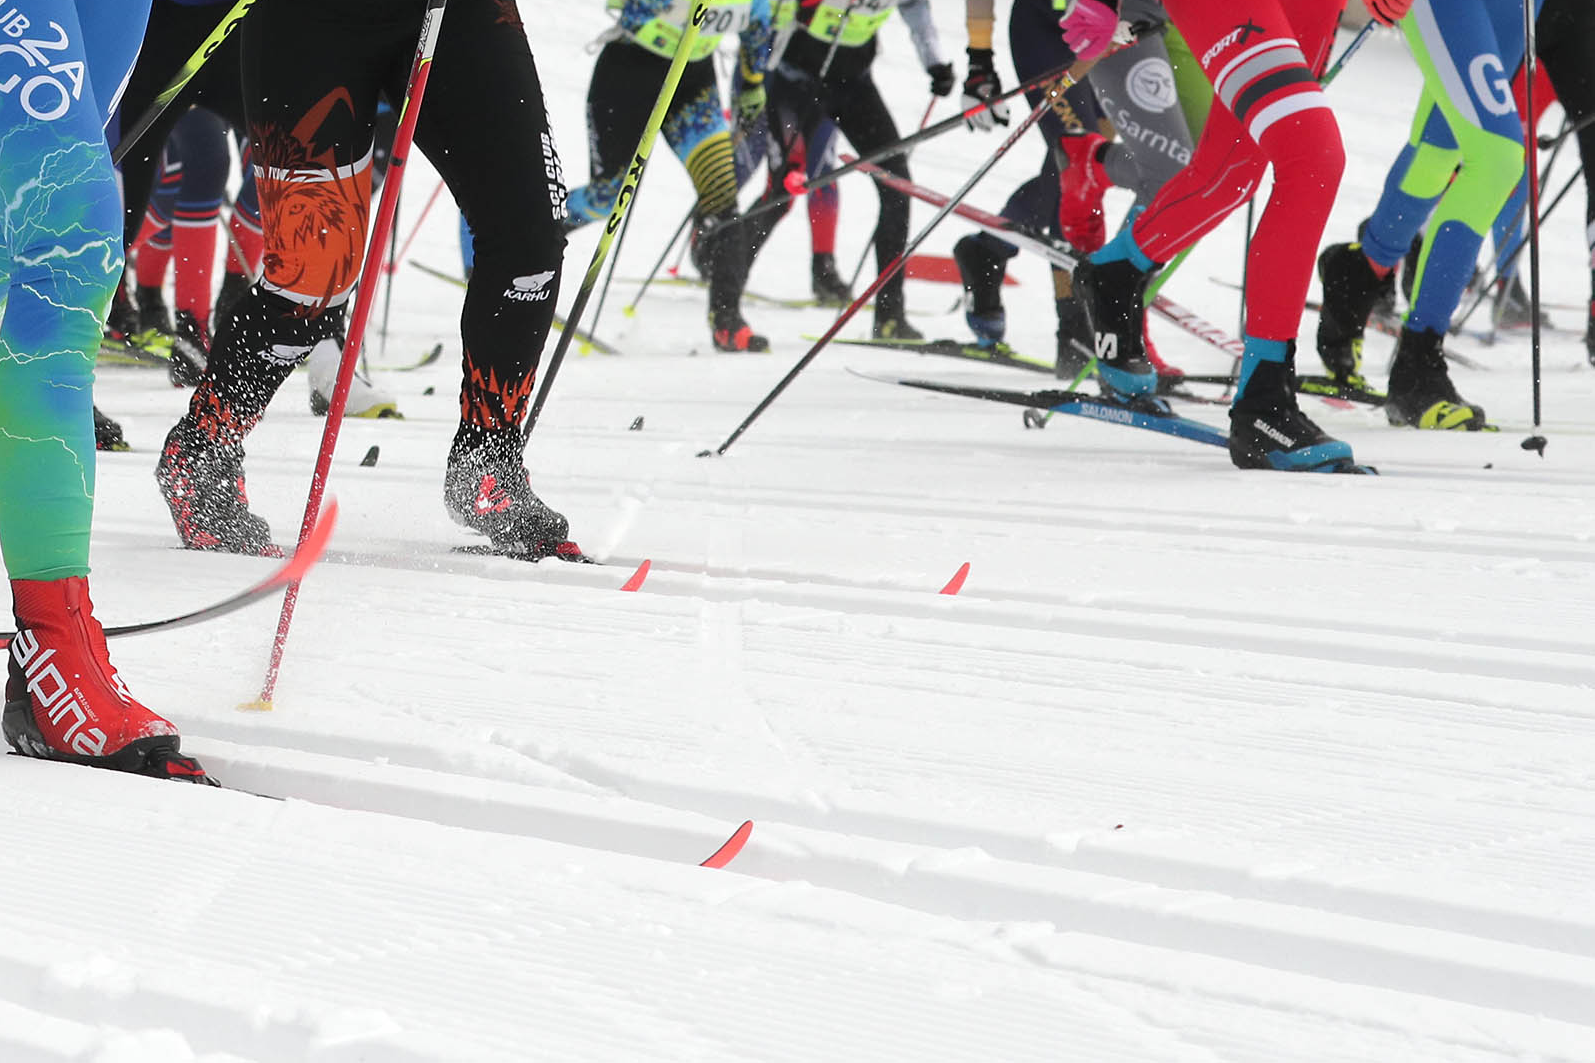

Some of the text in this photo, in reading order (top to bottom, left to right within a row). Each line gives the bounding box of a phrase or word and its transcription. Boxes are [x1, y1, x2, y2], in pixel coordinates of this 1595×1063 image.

[540, 131, 556, 180] CLUB
[547, 182, 561, 221] SCI
[606, 152, 649, 237] RCS
[503, 288, 550, 303] KARHU
[1081, 403, 1133, 426] SALOMON
[1253, 418, 1296, 448] SALOMON
[11, 629, 107, 757] alpina
